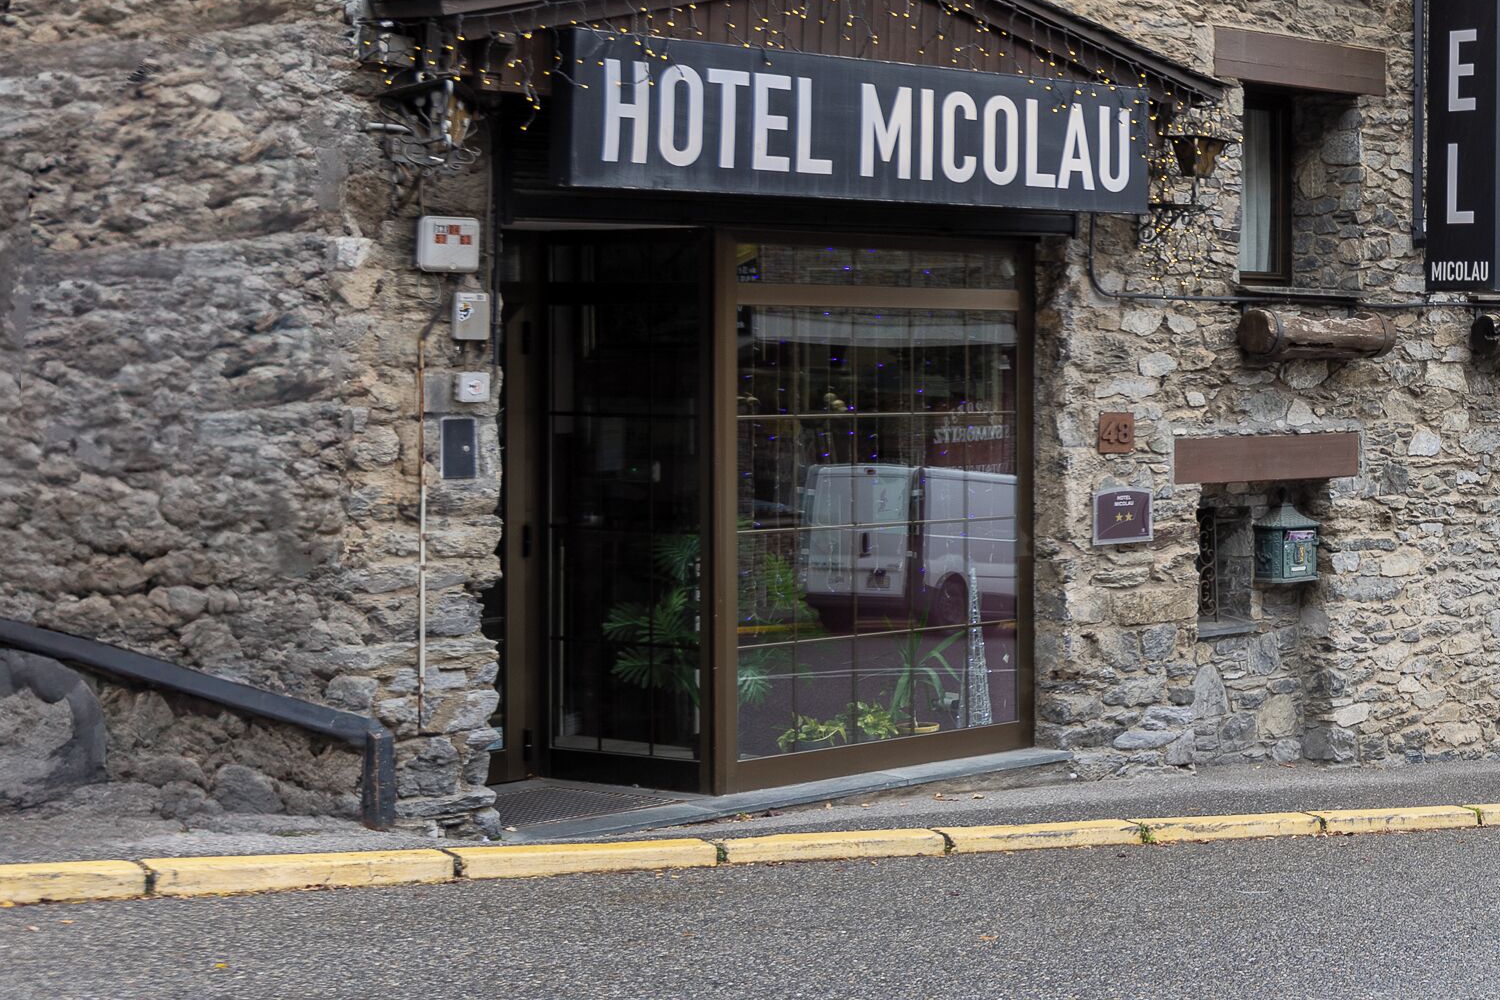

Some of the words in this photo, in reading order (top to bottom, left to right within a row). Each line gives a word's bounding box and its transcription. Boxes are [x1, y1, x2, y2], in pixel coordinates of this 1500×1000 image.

[602, 58, 832, 175] HOTEL
[860, 83, 1130, 193] MICOLAU
[1431, 261, 1488, 281] MICOLAU
[1102, 421, 1131, 444] 48
